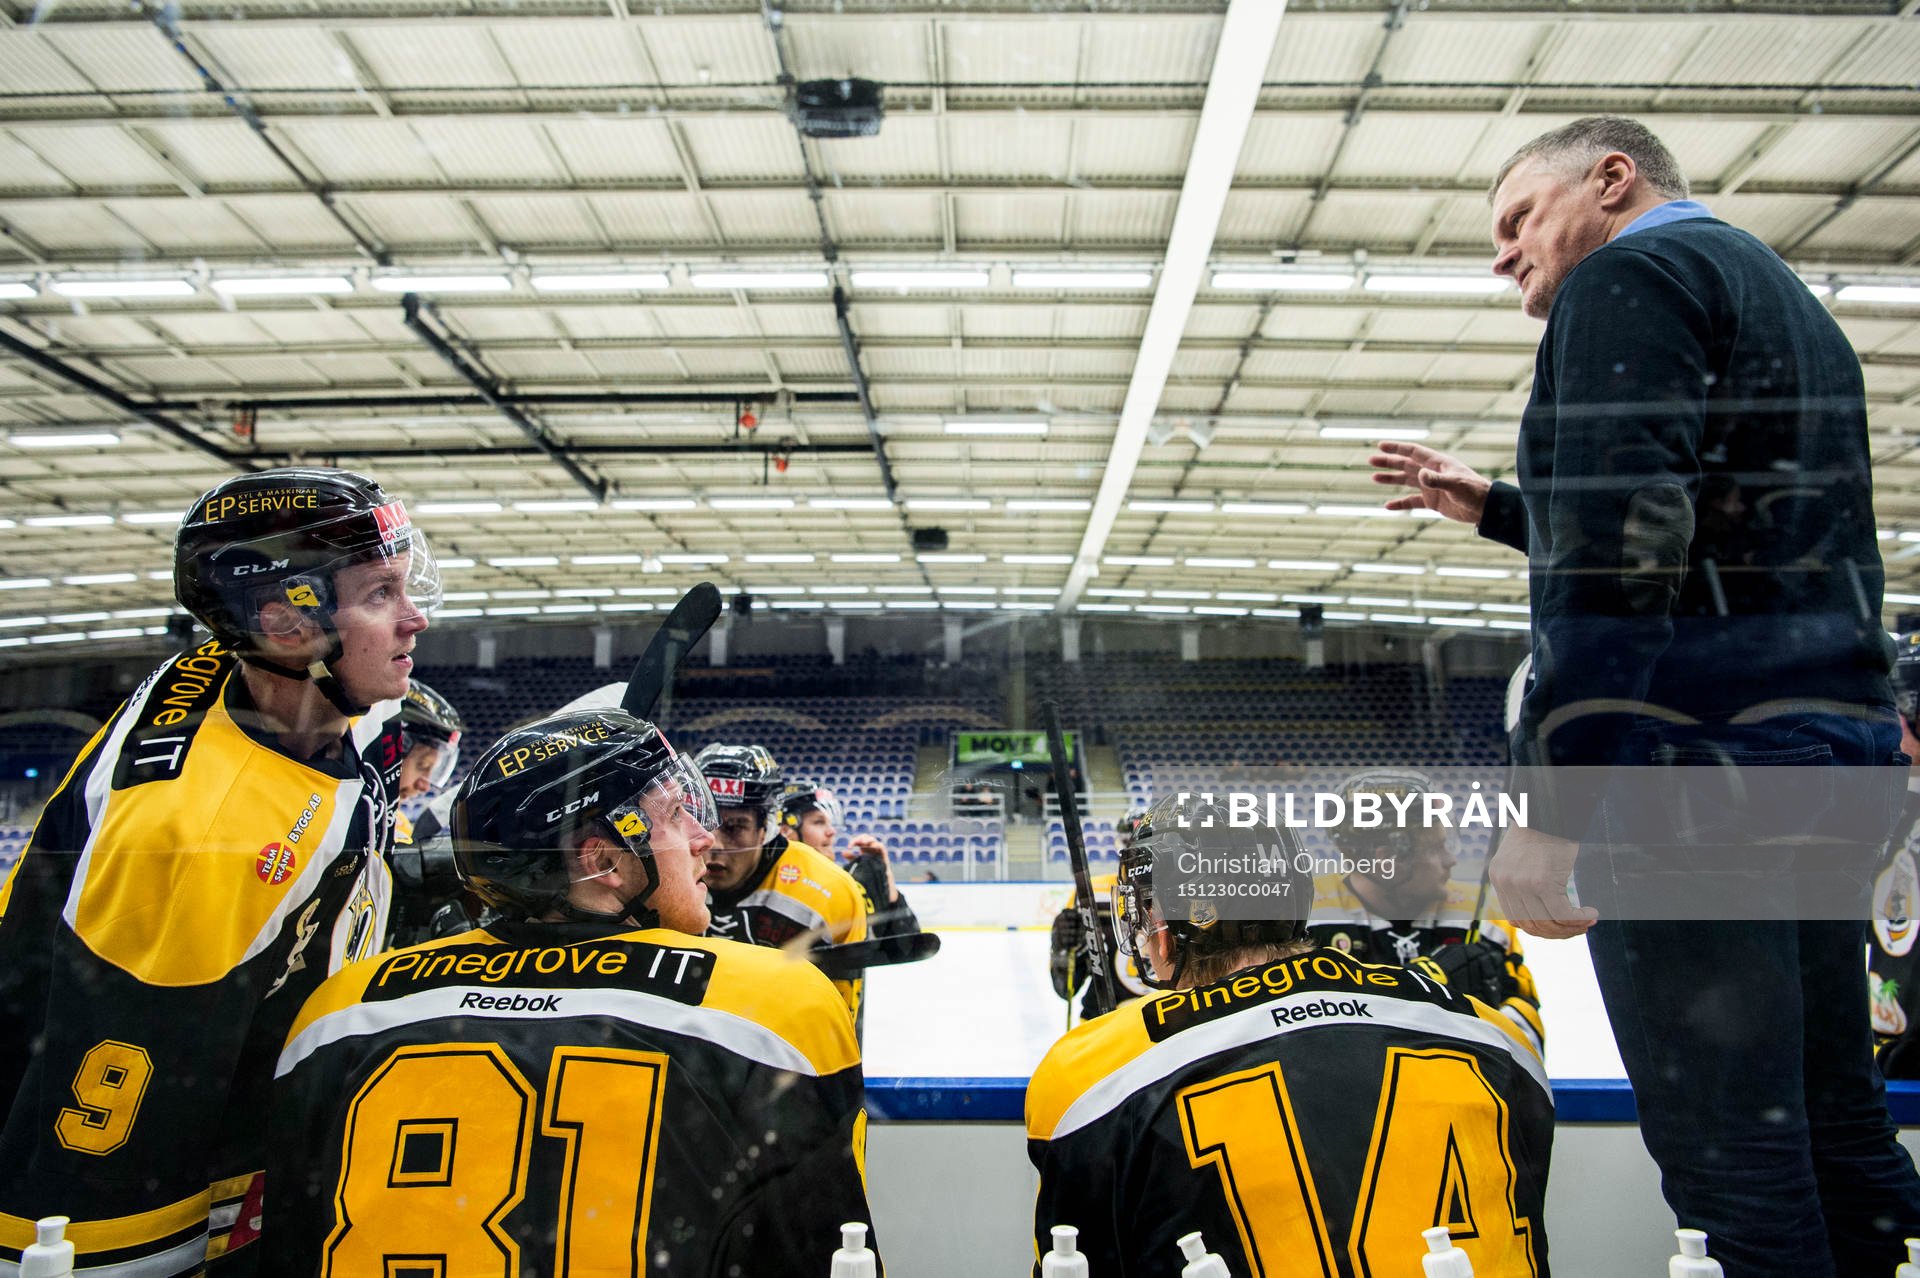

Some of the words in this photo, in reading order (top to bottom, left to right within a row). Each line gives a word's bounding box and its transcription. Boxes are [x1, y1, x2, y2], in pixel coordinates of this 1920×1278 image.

[205, 496, 236, 522] EP
[238, 495, 317, 515] SERVICE
[134, 736, 186, 770] IT
[498, 747, 530, 778] EP
[534, 727, 609, 761] SERVICE
[971, 736, 1032, 752] MOVE
[703, 777, 744, 796] AXI
[288, 809, 313, 844] BYGG
[308, 793, 322, 812] AB
[546, 790, 600, 823] CCM
[261, 848, 278, 874] TEAM
[274, 849, 292, 881] SKÅNE
[1128, 863, 1153, 878] CCM
[1081, 907, 1104, 977] CCM
[378, 947, 628, 986] Pinegrove
[647, 949, 705, 985] IT
[459, 992, 563, 1013] Reebok
[1155, 956, 1399, 1025] Pinegrove
[1271, 999, 1374, 1028] Reebok
[54, 1039, 155, 1157] 9
[321, 1042, 670, 1278] 81
[1175, 1046, 1538, 1278] 14
